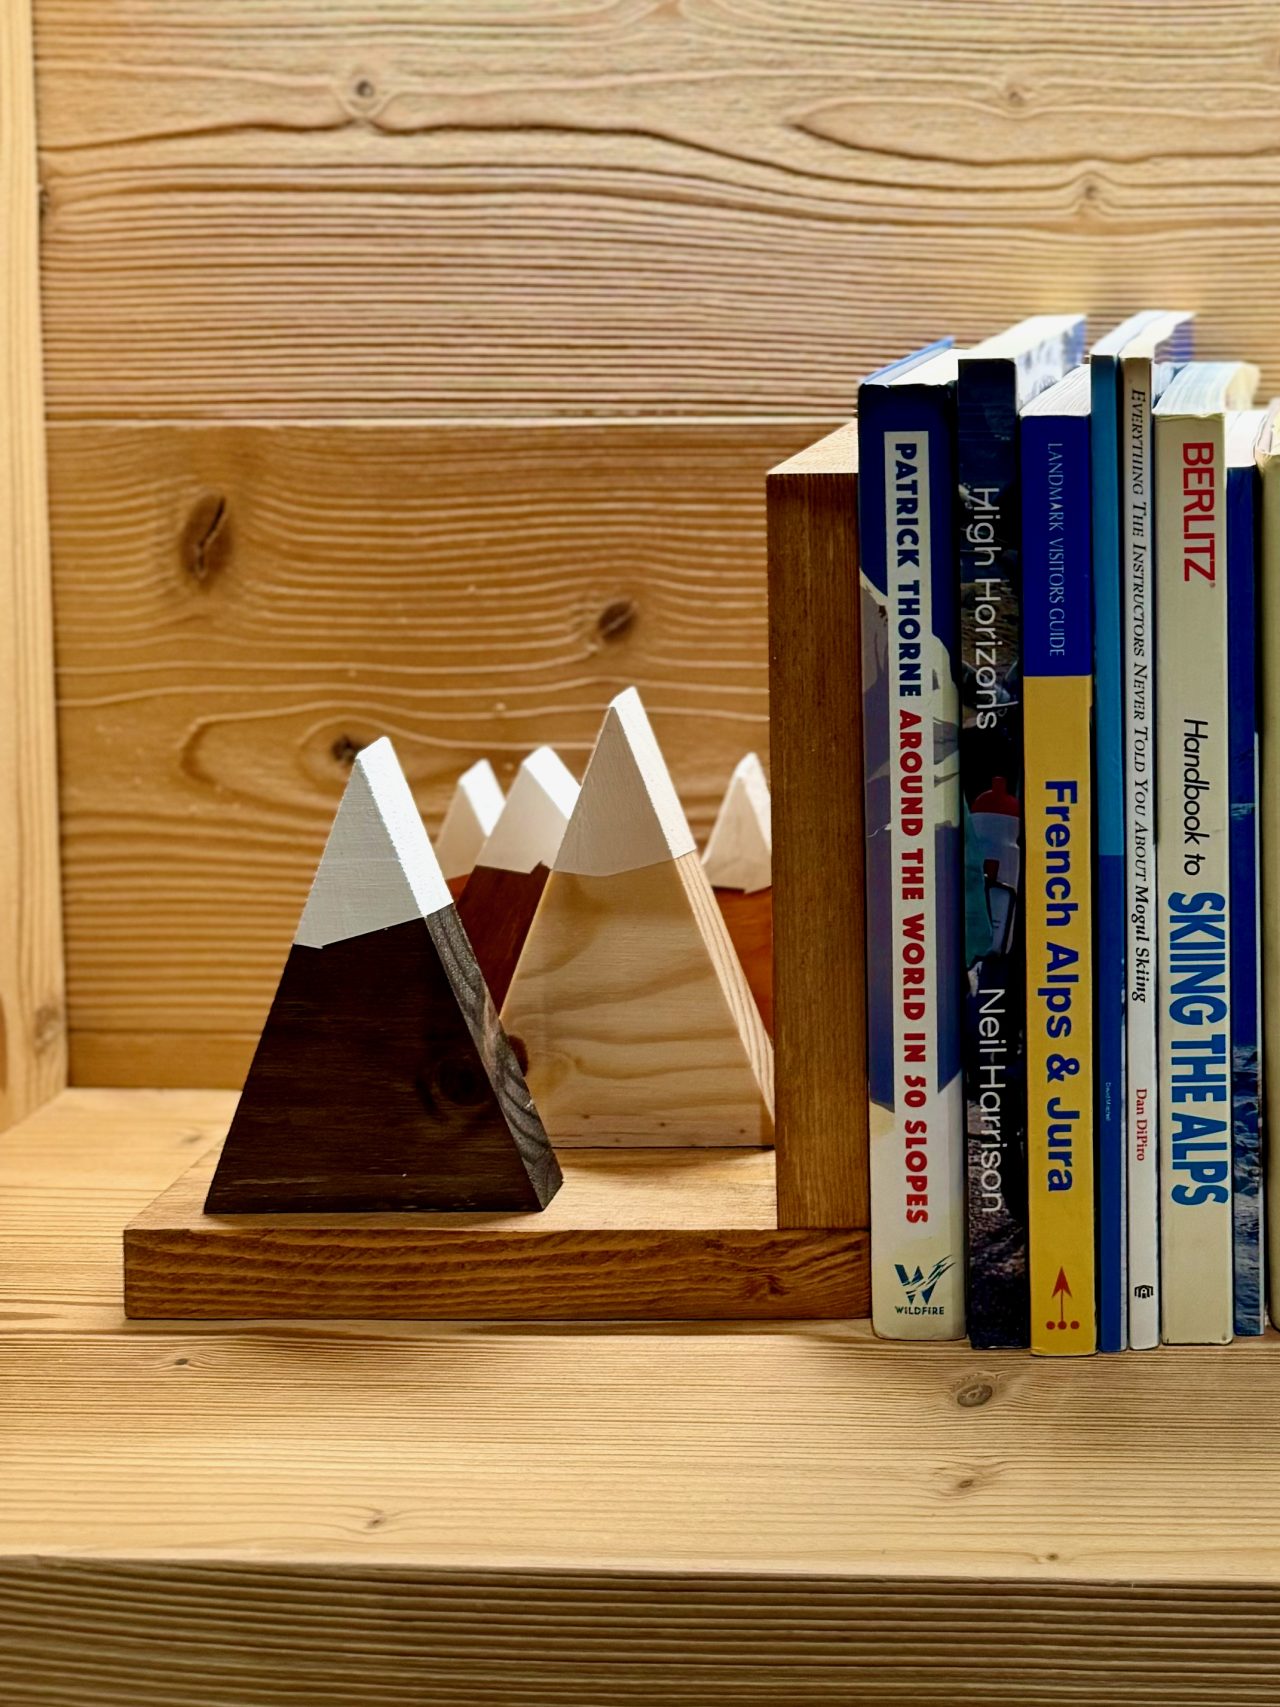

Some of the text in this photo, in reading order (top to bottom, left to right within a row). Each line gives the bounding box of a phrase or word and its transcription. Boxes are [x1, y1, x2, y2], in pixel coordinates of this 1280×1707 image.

[895, 443, 921, 697] PATRICK THORNE
[1048, 443, 1065, 657] LANDMARK VISITORS GUIDE
[1183, 441, 1216, 582] BERLITZ
[967, 488, 1002, 730] High Horizons
[899, 710, 923, 836] AROUND
[1183, 719, 1208, 876] Handbook to
[899, 848, 925, 900] THE
[1131, 884, 1150, 943] Mogul
[902, 913, 924, 1020] WORLD
[1037, 780, 1080, 1192] French Alps & Jura
[1132, 947, 1150, 1003] Skiing
[904, 1033, 925, 1062] IN
[979, 989, 1007, 1213] Neil Harrison
[1167, 892, 1229, 1205] SKIING THE ALPS
[905, 1121, 928, 1223] SLOPES
[1135, 1088, 1148, 1161] Dan DiPiro
[894, 1306, 945, 1315] WILDFIRE
